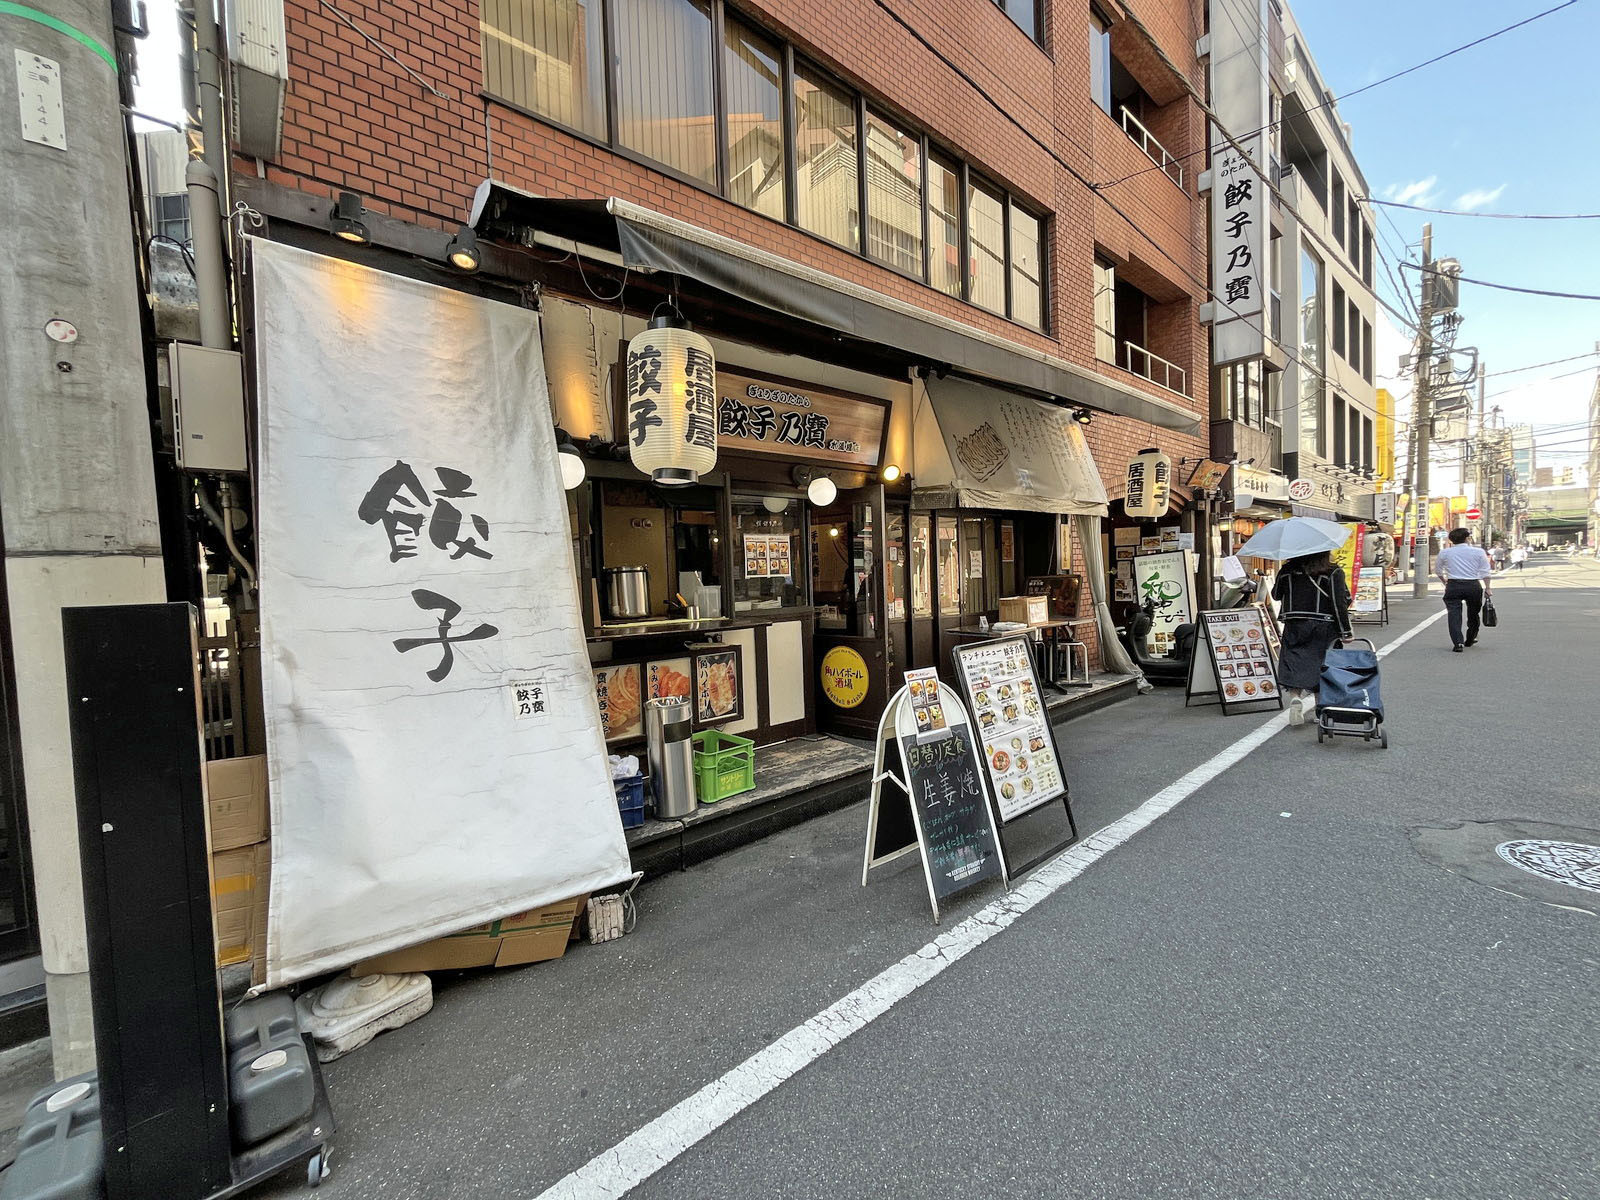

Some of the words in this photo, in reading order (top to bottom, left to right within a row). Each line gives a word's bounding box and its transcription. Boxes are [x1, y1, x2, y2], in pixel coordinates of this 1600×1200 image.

[1223, 178, 1254, 306] 餃子乃寶
[627, 344, 662, 447] 餃子
[684, 346, 715, 452] 居酒屋
[718, 396, 830, 450] 餃子乃寶
[1127, 462, 1145, 508] 居酒屋
[357, 459, 500, 683] 餃子
[825, 665, 864, 679] 角ハイボール
[962, 649, 1002, 661] ランチメニュー
[516, 687, 544, 702] 餃子
[519, 700, 545, 716] 乃寶
[908, 736, 967, 767] 日替り定食
[923, 767, 980, 809] 生姜焼
